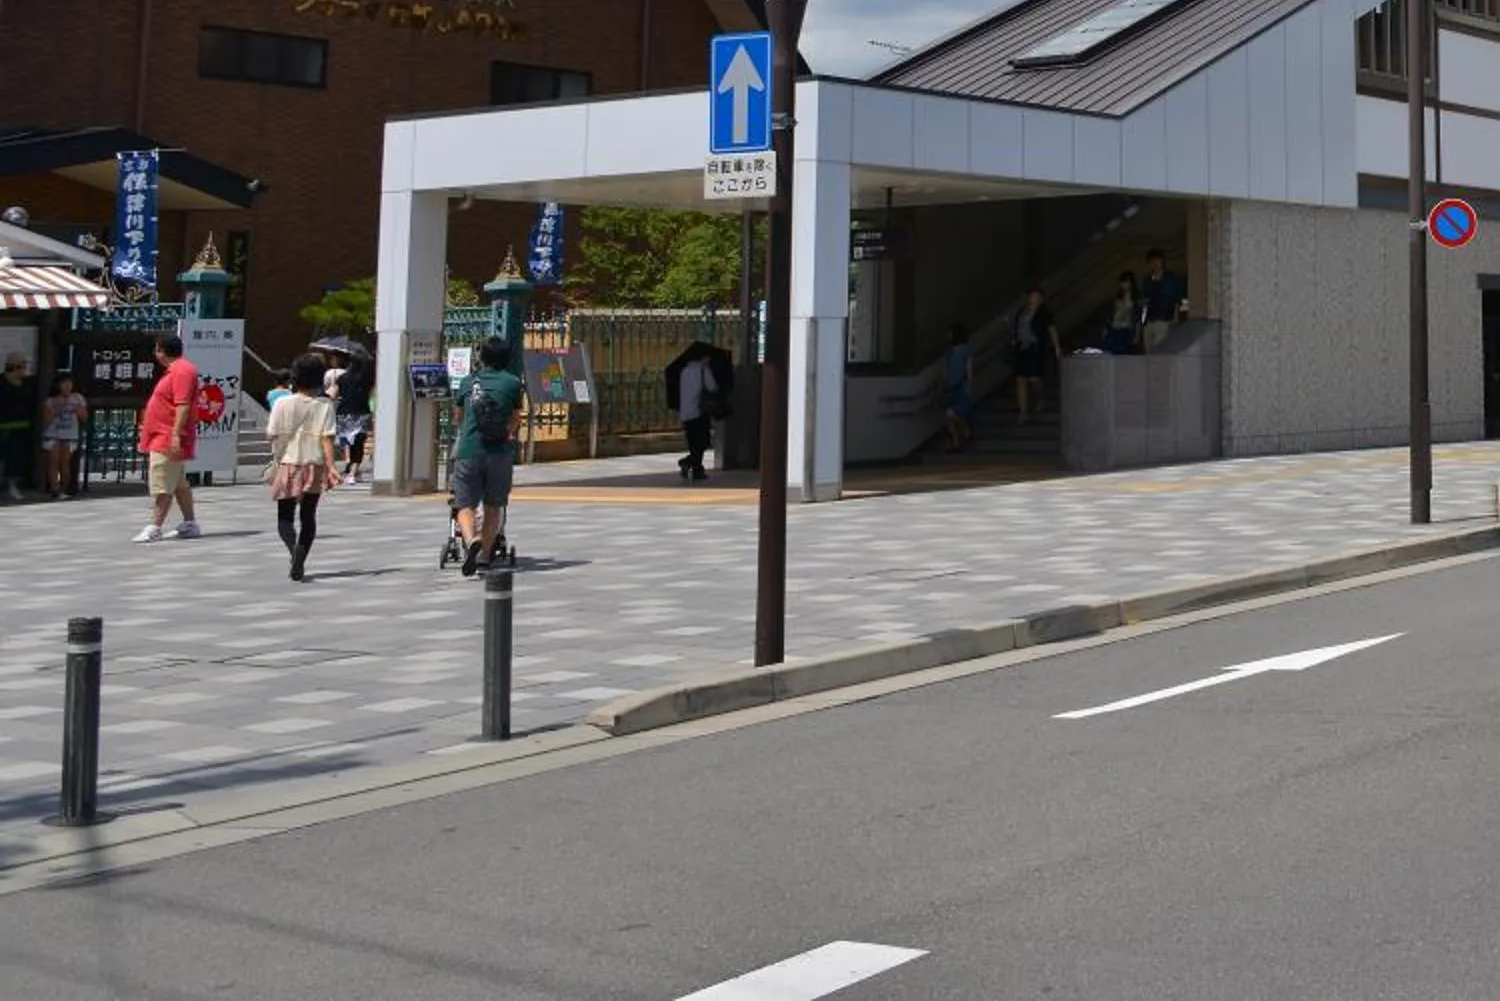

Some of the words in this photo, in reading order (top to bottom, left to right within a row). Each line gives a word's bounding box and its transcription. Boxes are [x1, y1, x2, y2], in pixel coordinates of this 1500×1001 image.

[707, 159, 772, 174] 自転車を除く
[713, 176, 767, 193] ここから
